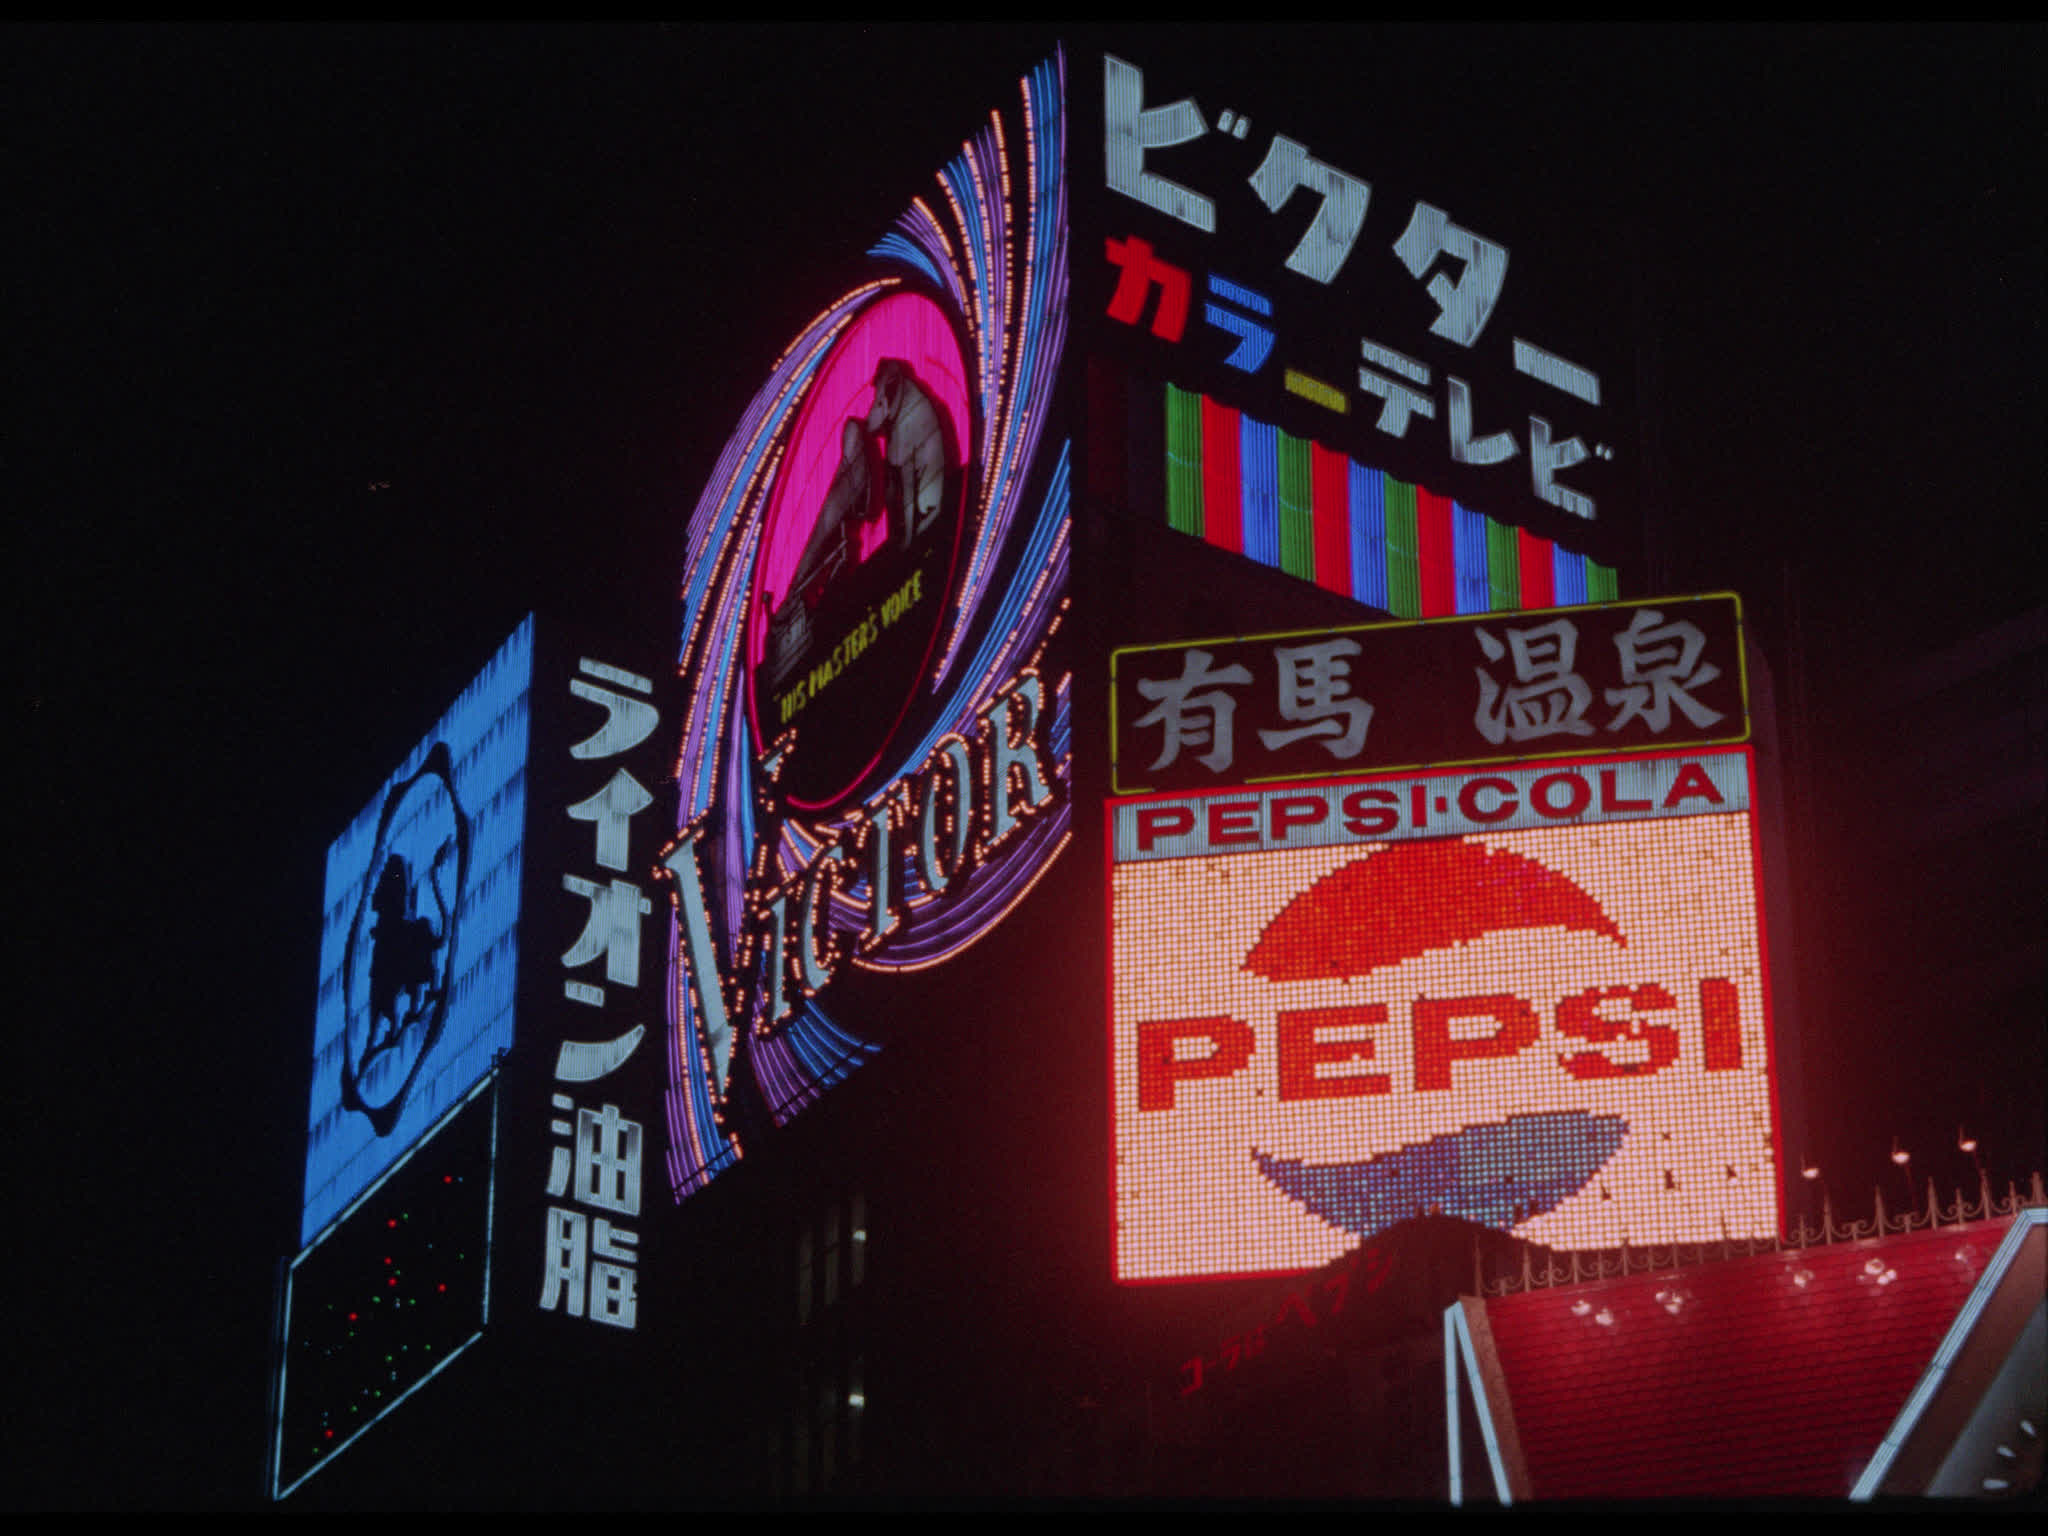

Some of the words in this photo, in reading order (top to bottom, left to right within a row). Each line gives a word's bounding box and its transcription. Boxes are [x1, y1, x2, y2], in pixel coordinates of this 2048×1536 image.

[1104, 52, 1600, 407] ビクター
[1105, 234, 1613, 520] カラーテレビ
[1132, 637, 1375, 773] 有馬
[1473, 608, 1725, 747] 温泉
[540, 656, 660, 1329] ライオン油脂
[652, 666, 1052, 1100] VICTOR
[1137, 977, 1743, 1113] PEPSI
